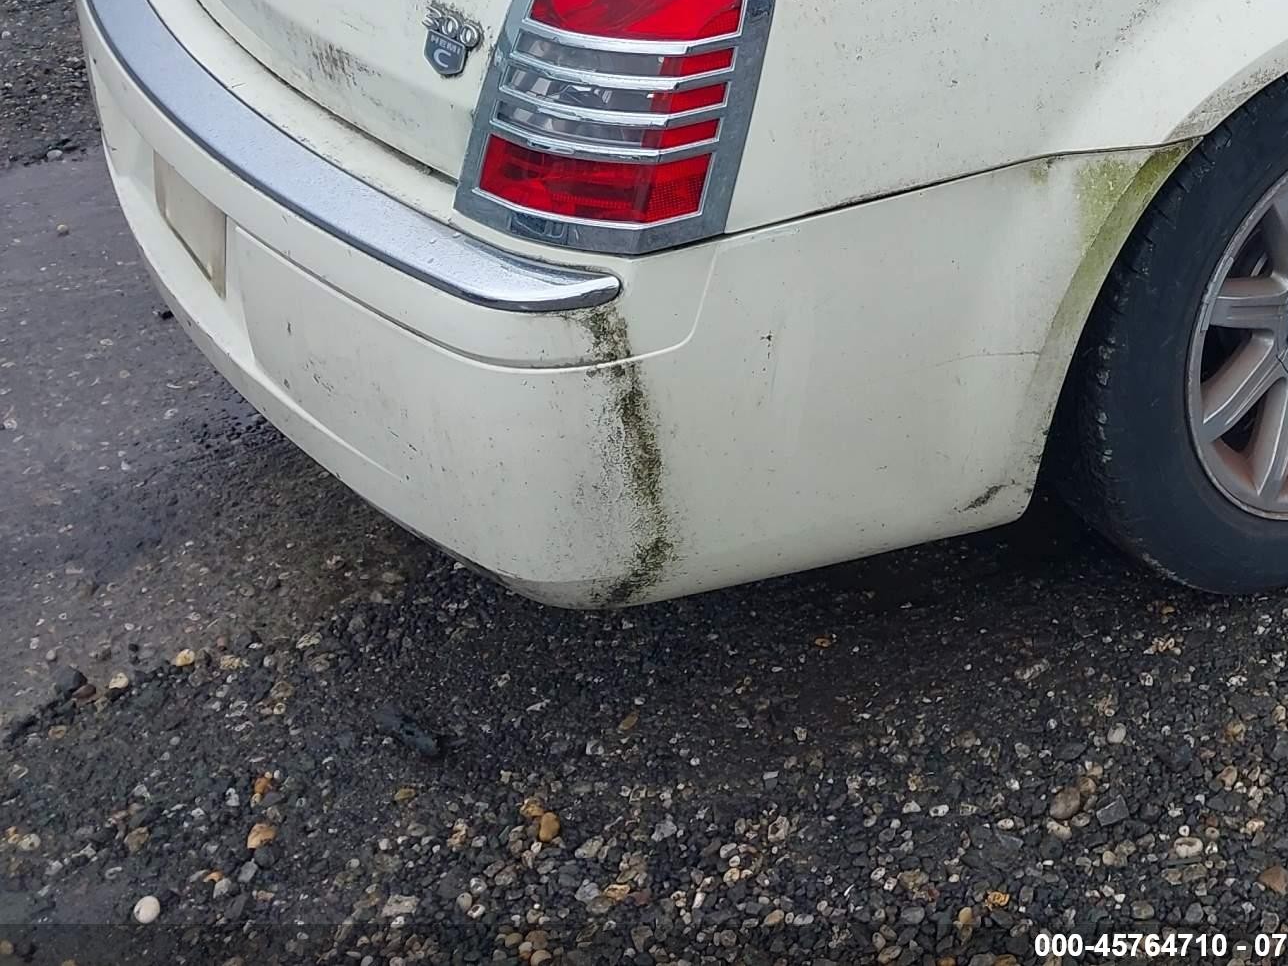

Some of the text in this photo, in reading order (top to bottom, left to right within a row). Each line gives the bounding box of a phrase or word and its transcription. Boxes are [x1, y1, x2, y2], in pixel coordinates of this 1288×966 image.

[421, 5, 480, 48] 300
[430, 33, 463, 56] HEMI
[432, 48, 452, 69] C
